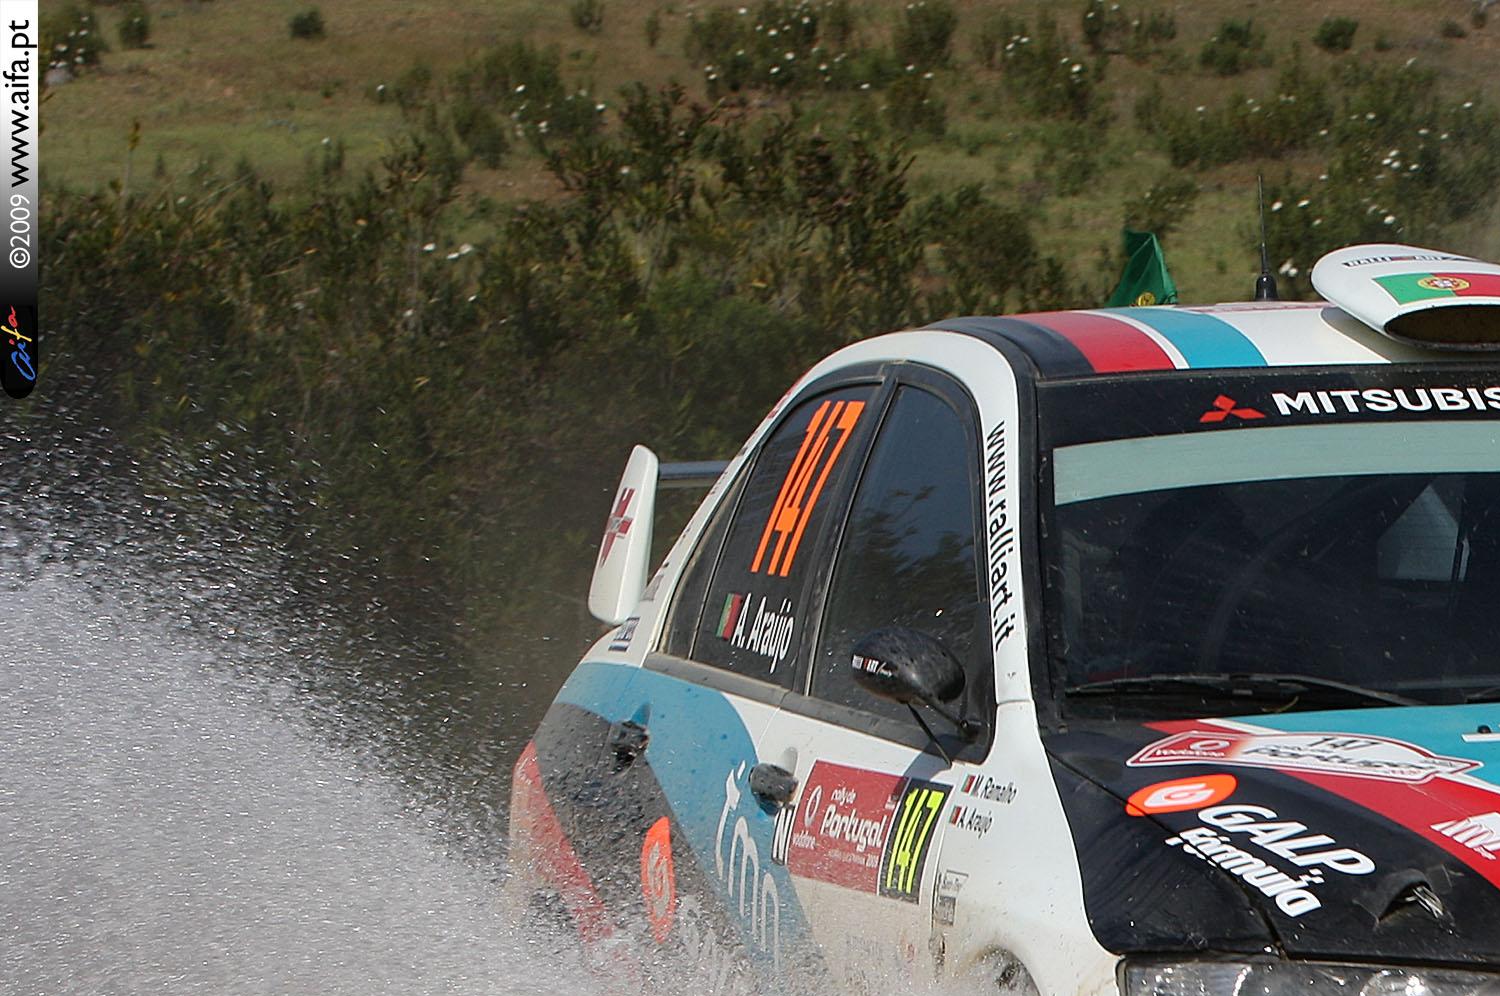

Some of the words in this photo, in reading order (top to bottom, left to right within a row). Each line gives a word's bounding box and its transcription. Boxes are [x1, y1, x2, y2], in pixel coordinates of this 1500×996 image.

[750, 400, 866, 577] 147
[986, 420, 1016, 652] www.ralliart.it
[886, 788, 946, 894] 147
[1198, 804, 1376, 875] GALP
